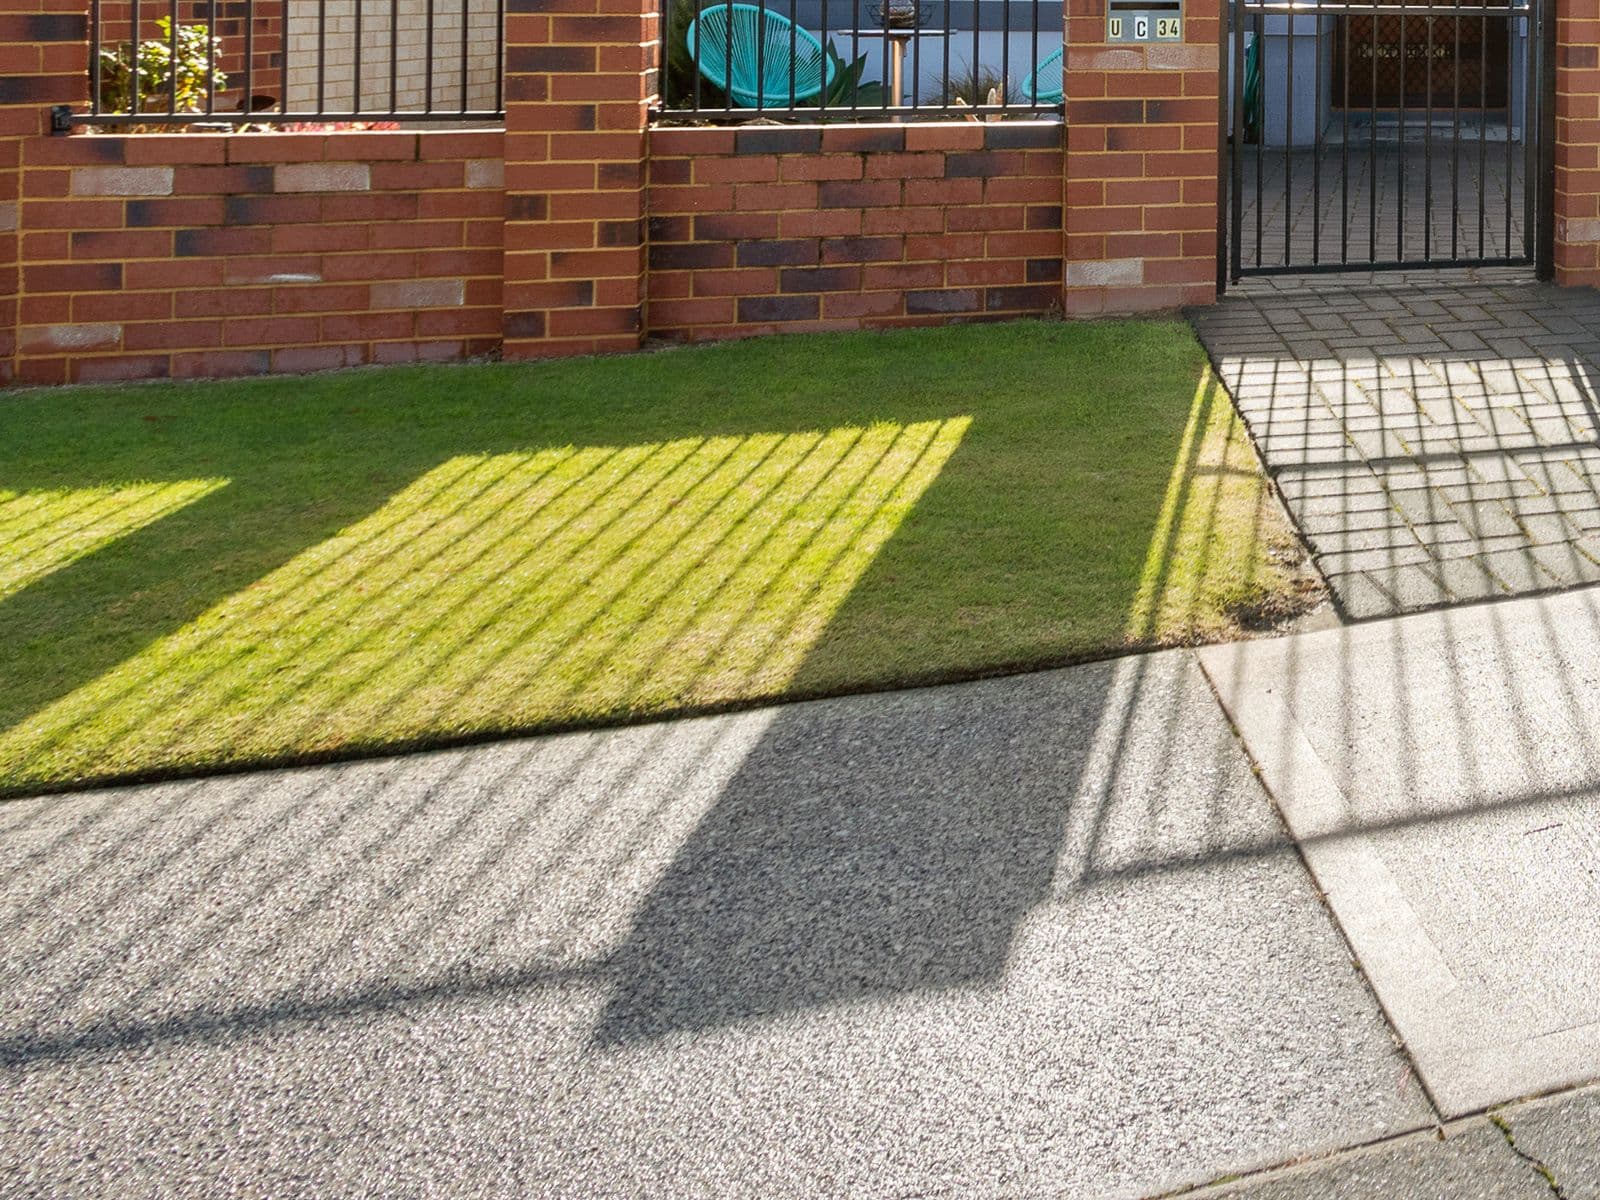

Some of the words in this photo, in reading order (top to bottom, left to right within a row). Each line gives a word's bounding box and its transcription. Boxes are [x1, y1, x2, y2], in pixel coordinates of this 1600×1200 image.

[1111, 19, 1120, 36] U
[1137, 20, 1146, 37] C
[1159, 19, 1178, 36] 34
